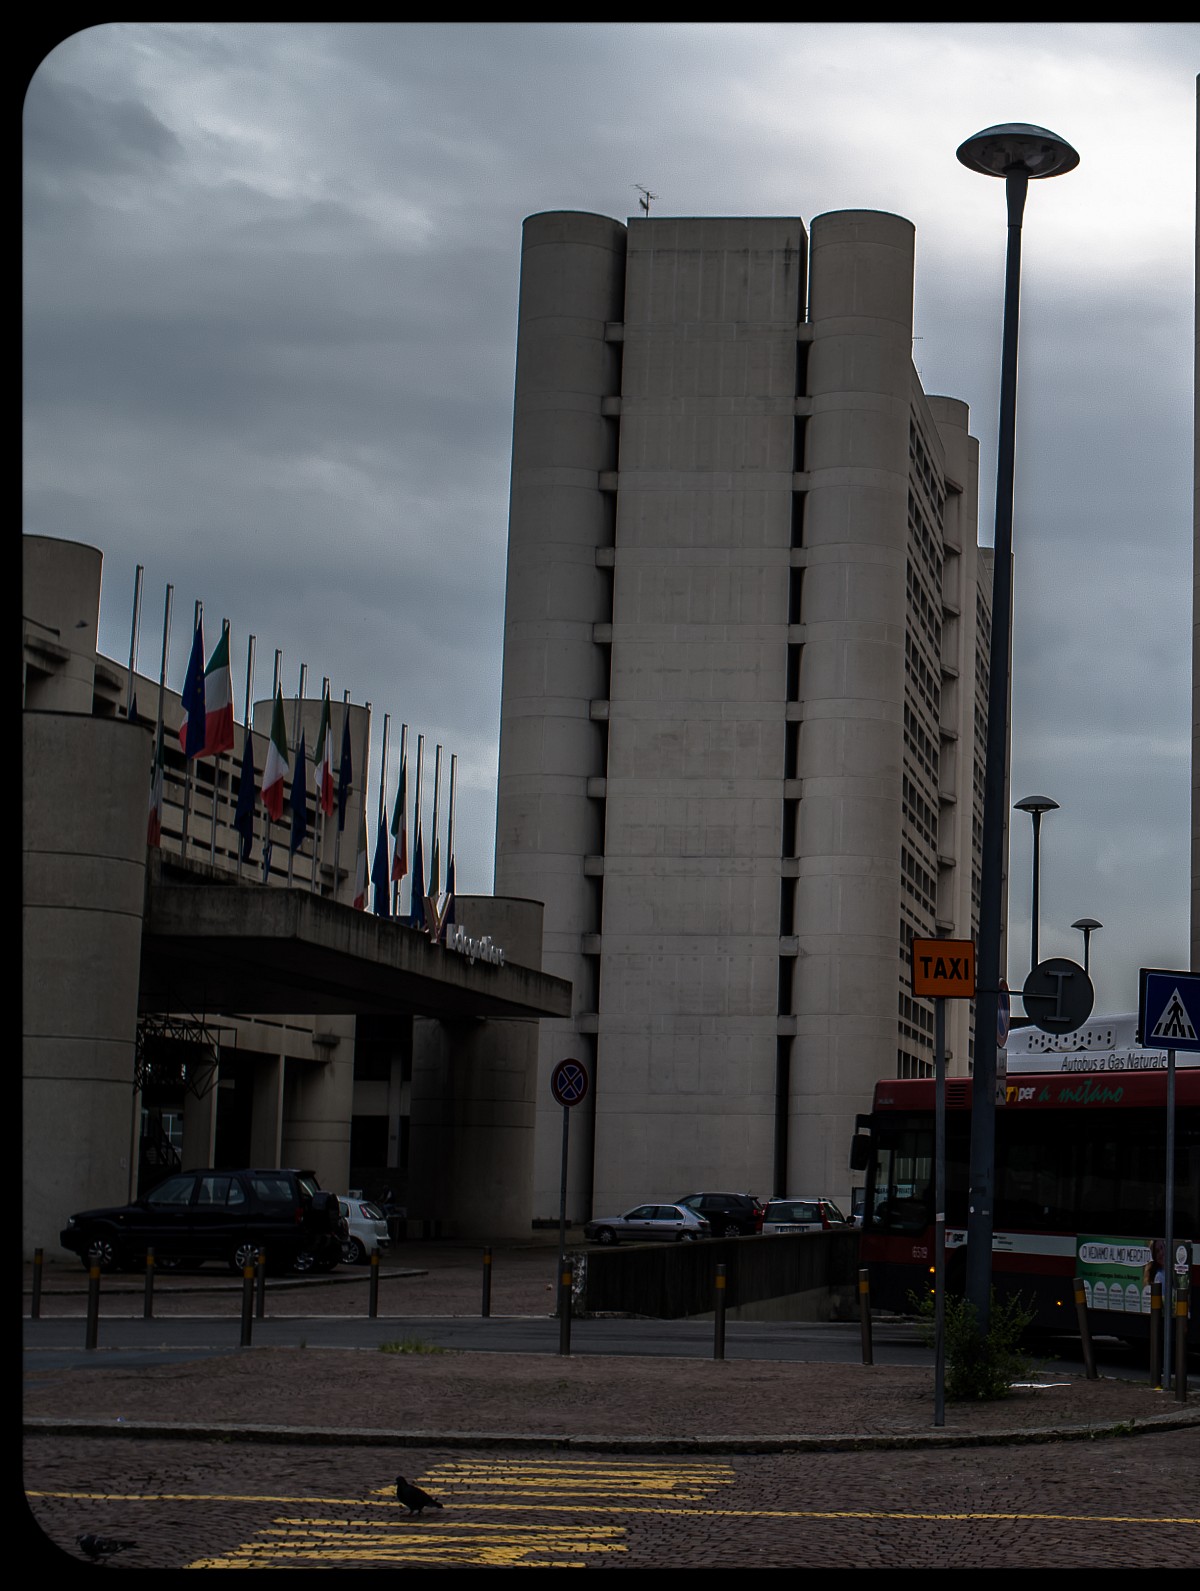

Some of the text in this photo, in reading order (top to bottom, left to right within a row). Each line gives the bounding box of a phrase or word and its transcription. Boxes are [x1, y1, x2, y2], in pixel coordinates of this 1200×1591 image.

[919, 956, 970, 980] TAXI
[1061, 1052, 1167, 1072] Autobus a Gas Naturale
